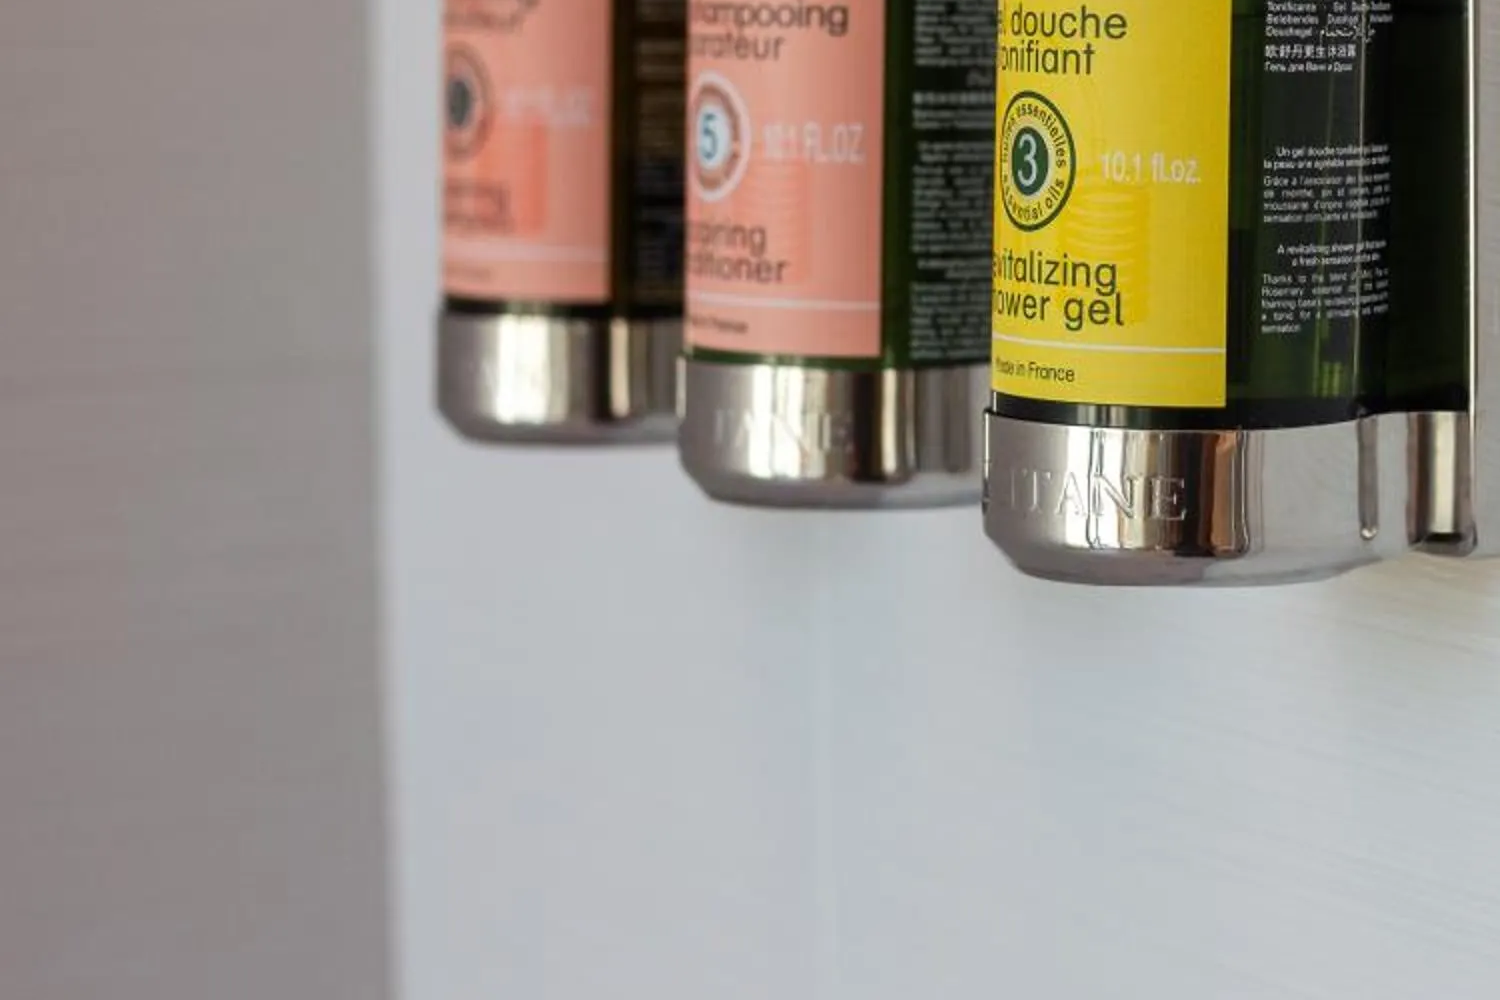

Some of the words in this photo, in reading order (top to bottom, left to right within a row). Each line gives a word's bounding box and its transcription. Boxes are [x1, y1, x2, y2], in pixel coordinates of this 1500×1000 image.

[1011, 2, 1128, 39] douche
[701, 112, 719, 160] 5
[1017, 133, 1038, 187] 3
[1101, 152, 1142, 183] 10.1
[992, 288, 1050, 320] ower
[1063, 293, 1125, 331] gel
[1028, 360, 1076, 382] France
